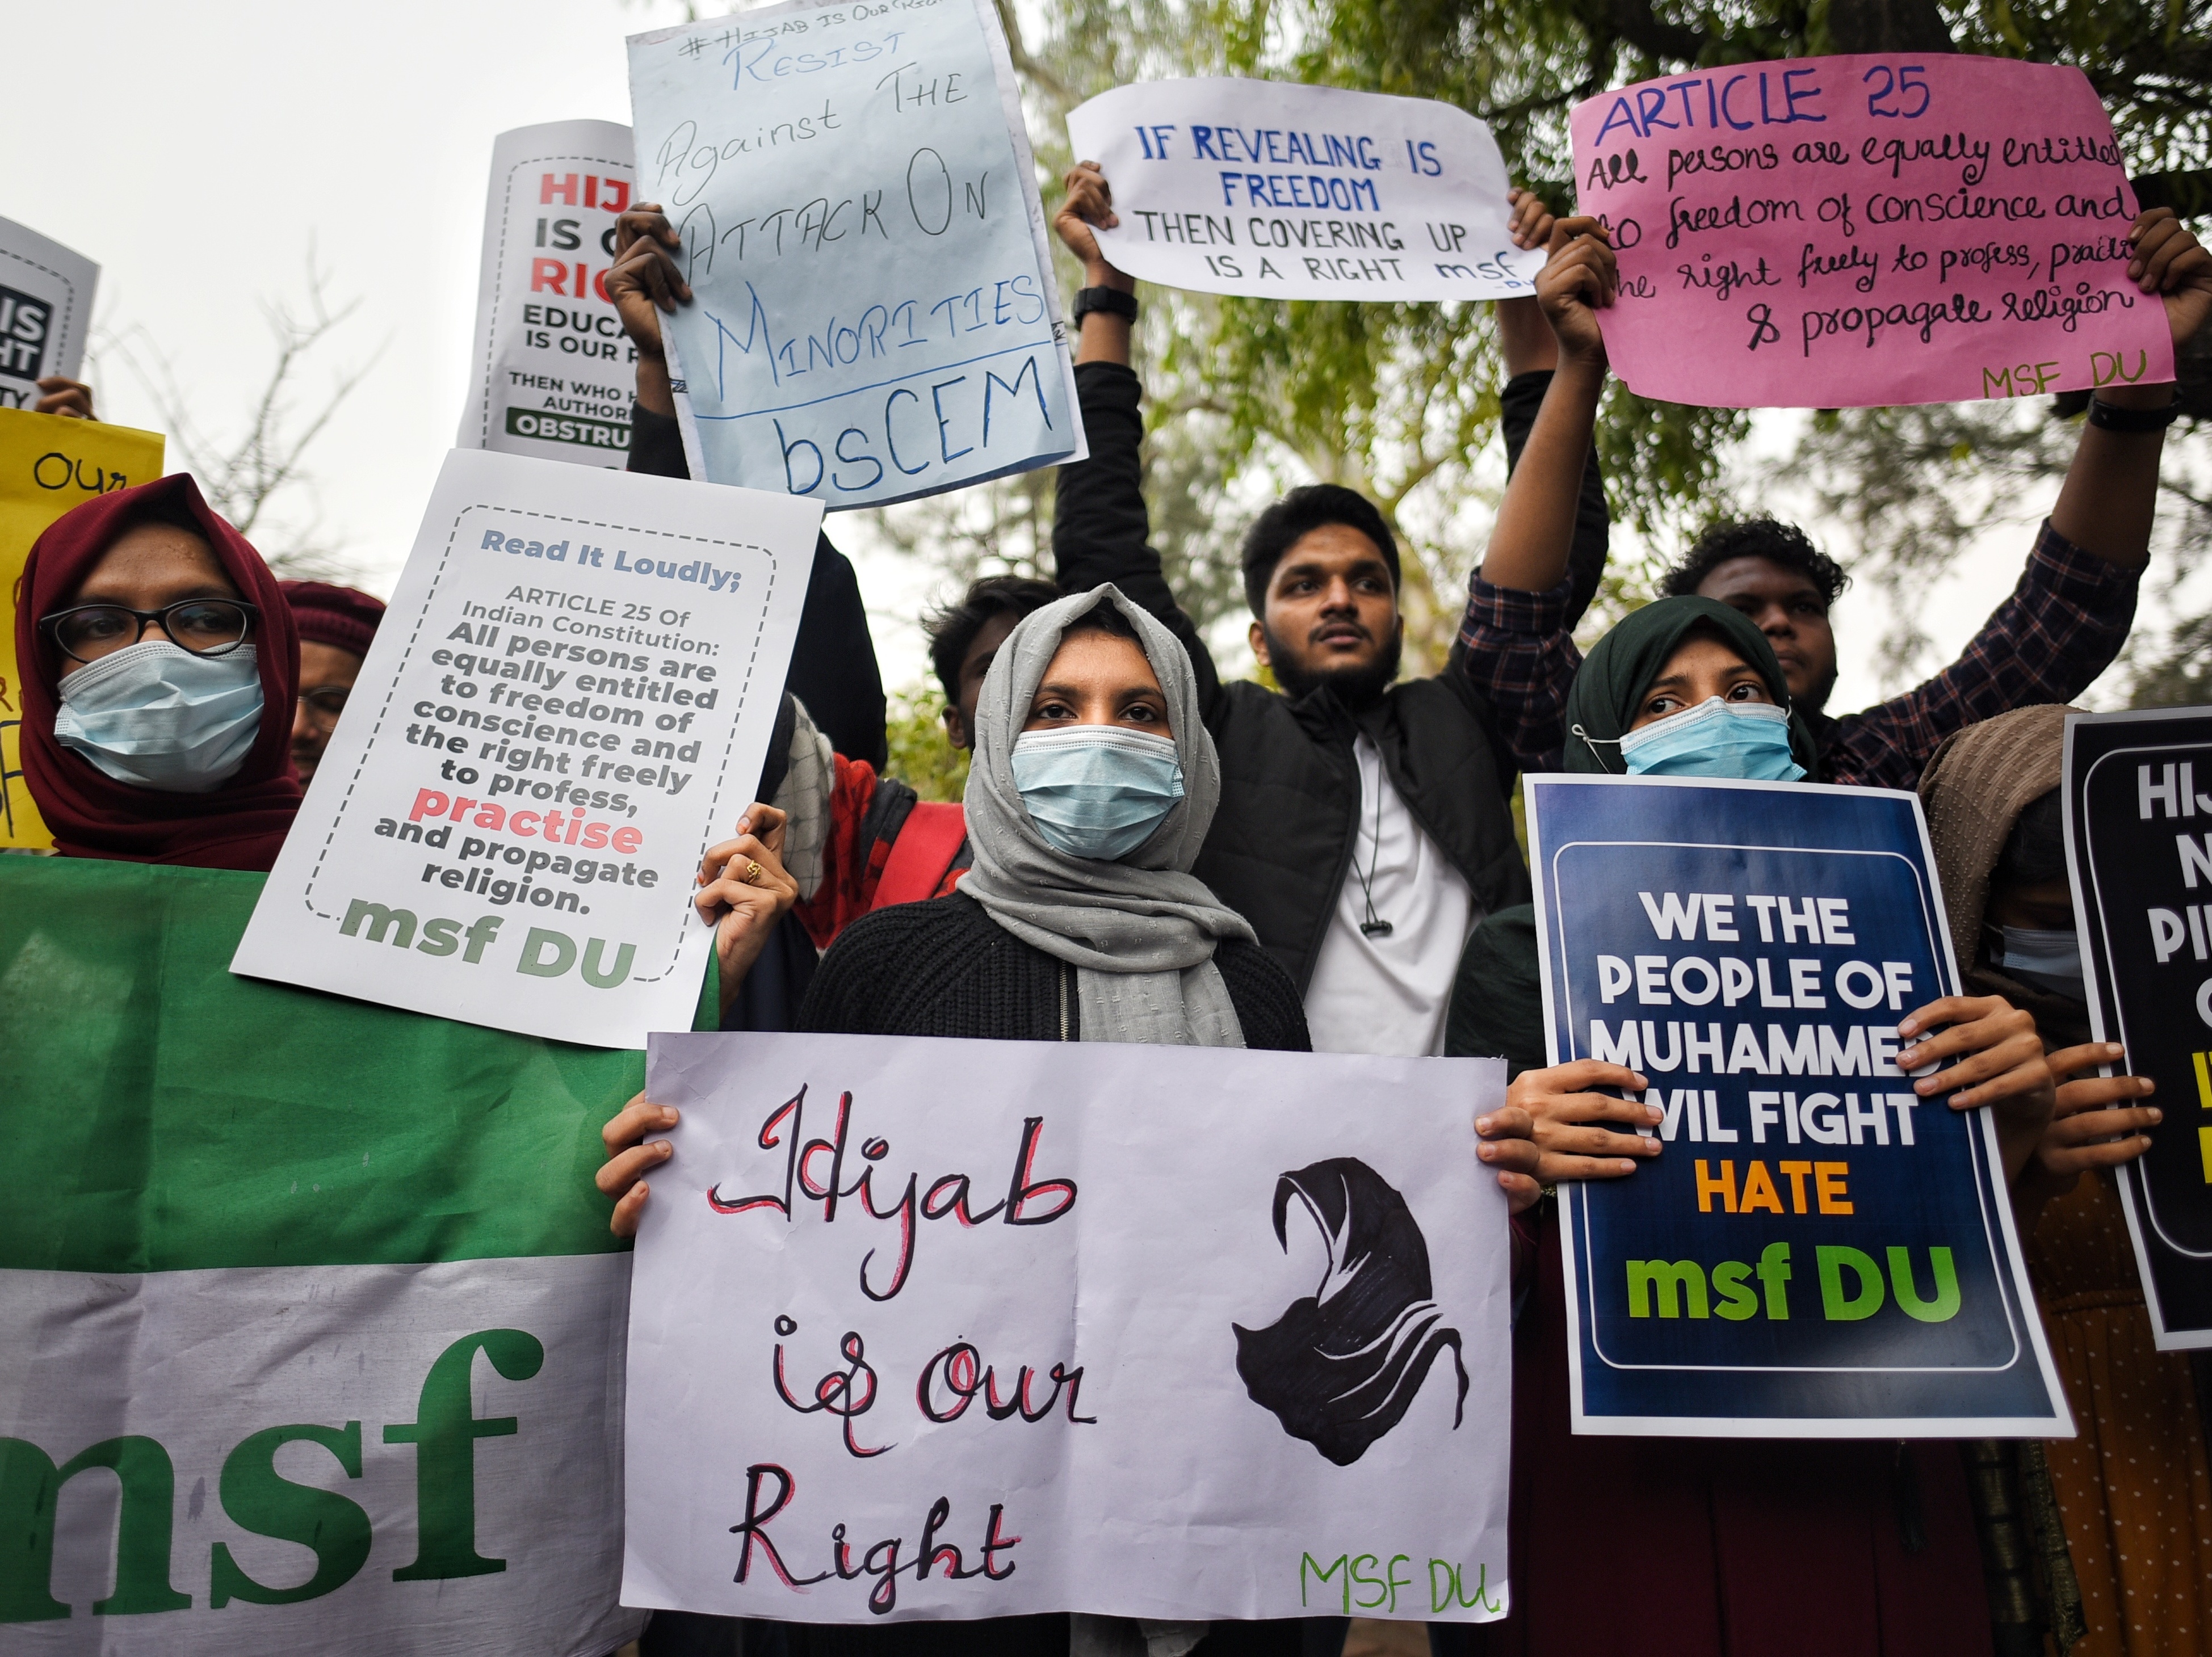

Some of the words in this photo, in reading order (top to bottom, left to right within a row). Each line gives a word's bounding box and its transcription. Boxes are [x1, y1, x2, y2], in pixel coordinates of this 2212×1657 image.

[818, 12, 846, 27] IS
[722, 32, 906, 91] RESIST
[1594, 67, 1827, 146] ARTICLE
[1862, 65, 1930, 118] 25
[656, 99, 842, 207] Against
[1134, 125, 1176, 161] IF
[1193, 125, 1381, 171] REVEALING
[1405, 139, 1444, 178] IS
[1586, 147, 1648, 191] All
[1667, 142, 1779, 192] persons
[1792, 141, 1850, 165] are
[1861, 132, 1991, 186] equally
[678, 190, 889, 287] ATTACK
[907, 148, 989, 236] ON
[1219, 171, 1381, 212] FREEDOM
[1665, 195, 1807, 249] freedom
[1817, 193, 1855, 237] of
[1866, 186, 2047, 224] conscience
[2055, 186, 2137, 221] and
[535, 218, 582, 251] IS
[1132, 211, 1236, 247] THEN
[1248, 217, 1405, 253] COVERING
[1426, 222, 1467, 254] UP
[1204, 255, 1244, 279] IS
[1258, 258, 1285, 280] A
[1299, 258, 1406, 283] RIGHT
[1434, 250, 1518, 280] msf
[1615, 268, 1656, 298] he
[1677, 253, 1782, 301] right
[1798, 243, 1879, 293] freely
[1892, 244, 1929, 272] to
[525, 329, 551, 350] IS
[559, 335, 618, 363] OUR
[704, 275, 1045, 402] MINORITIES
[1747, 302, 1781, 351] &
[1802, 294, 1993, 357] propagate
[2001, 281, 2135, 334] religion
[508, 371, 564, 392] THEN
[570, 380, 622, 401] WHO
[1983, 361, 2062, 399] MSF
[2090, 349, 2148, 387] DU
[480, 529, 570, 562] Read
[577, 544, 605, 567] It
[614, 550, 742, 594] Loudly;
[461, 600, 544, 629] Indian
[551, 616, 720, 657] Constitution:
[505, 584, 616, 617] ARTICLE
[621, 603, 653, 622] 25
[658, 610, 692, 628] Of
[431, 648, 568, 691] equally
[575, 674, 719, 710] entitled
[446, 621, 500, 648] All
[505, 634, 649, 674] persons
[658, 659, 717, 683] are
[413, 700, 621, 751] conscience
[631, 738, 702, 764] and
[440, 674, 479, 699] to
[489, 682, 645, 727] freedom
[654, 712, 696, 734] of
[405, 723, 469, 754] the
[479, 738, 571, 772] right
[580, 754, 693, 794] freely
[440, 758, 480, 785] to
[488, 771, 639, 819] profess,
[408, 787, 644, 855] practise
[373, 817, 453, 850] and
[457, 835, 659, 889] propagate
[421, 863, 591, 915] religion.
[1638, 891, 1740, 942] WE
[1745, 894, 1856, 945] THE
[338, 898, 505, 965] msf
[515, 926, 638, 990] DU
[1597, 954, 1827, 1009] PEOPLE
[1835, 960, 1913, 1010] OF
[1748, 1091, 1919, 1146] FIGHT
[1694, 1159, 1854, 1215] HATE
[1626, 1242, 1792, 1320] msf
[1816, 1245, 1961, 1322] DU
[772, 1313, 900, 1458] is
[0, 1328, 544, 1624] msf
[729, 1462, 1023, 1615] Right
[1300, 1551, 1412, 1615] MSF
[1428, 1557, 1501, 1613] DU
